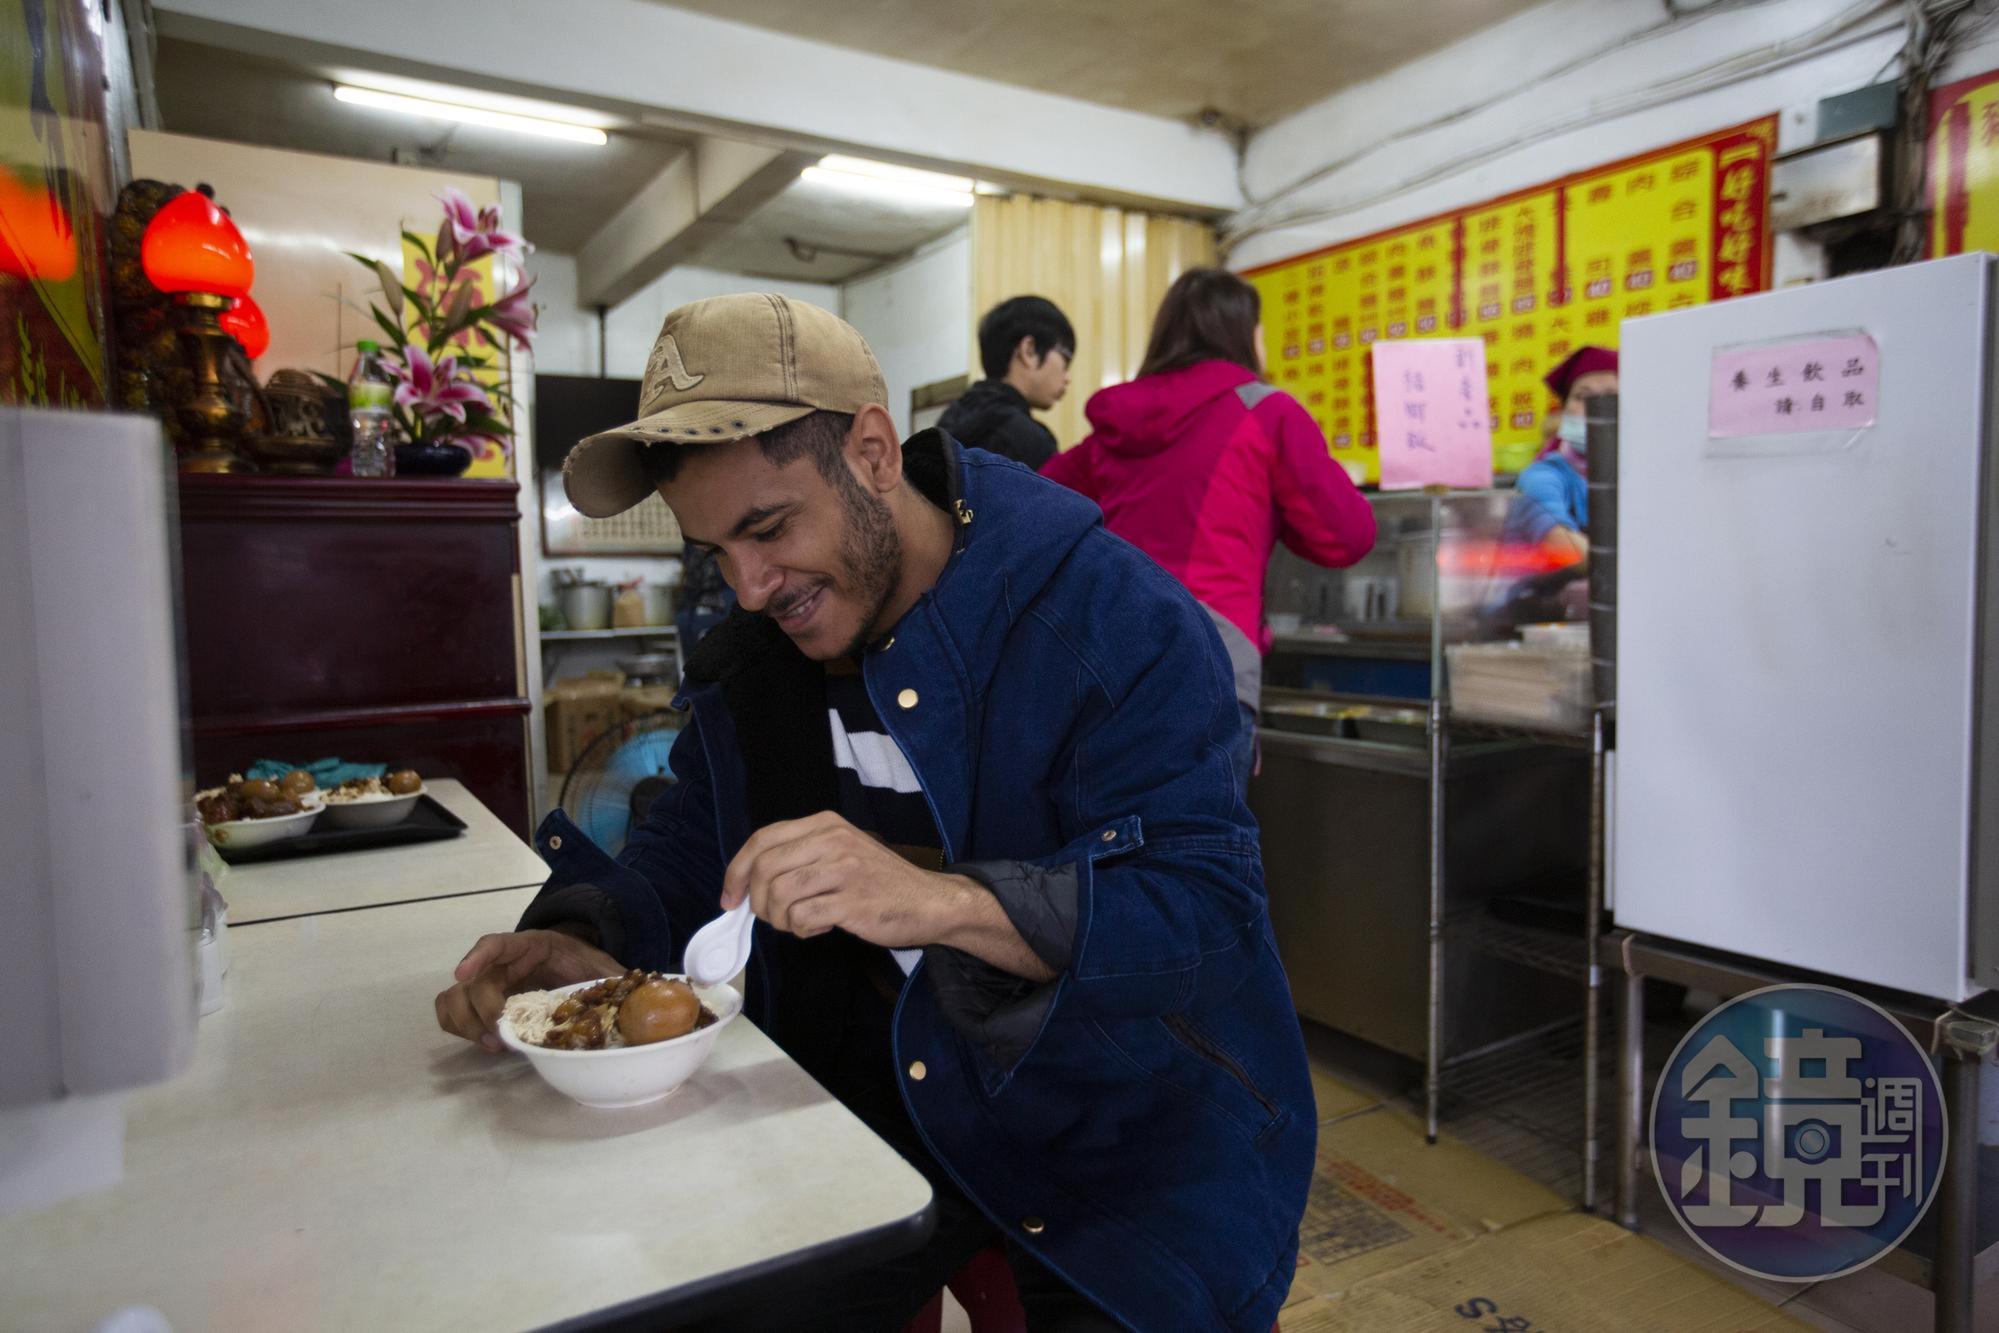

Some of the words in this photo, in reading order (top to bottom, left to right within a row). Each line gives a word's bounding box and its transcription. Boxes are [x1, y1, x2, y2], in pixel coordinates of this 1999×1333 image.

[642, 334, 704, 409] A
[1730, 358, 1864, 392] 養生飲品
[1774, 391, 1865, 415] 請自取
